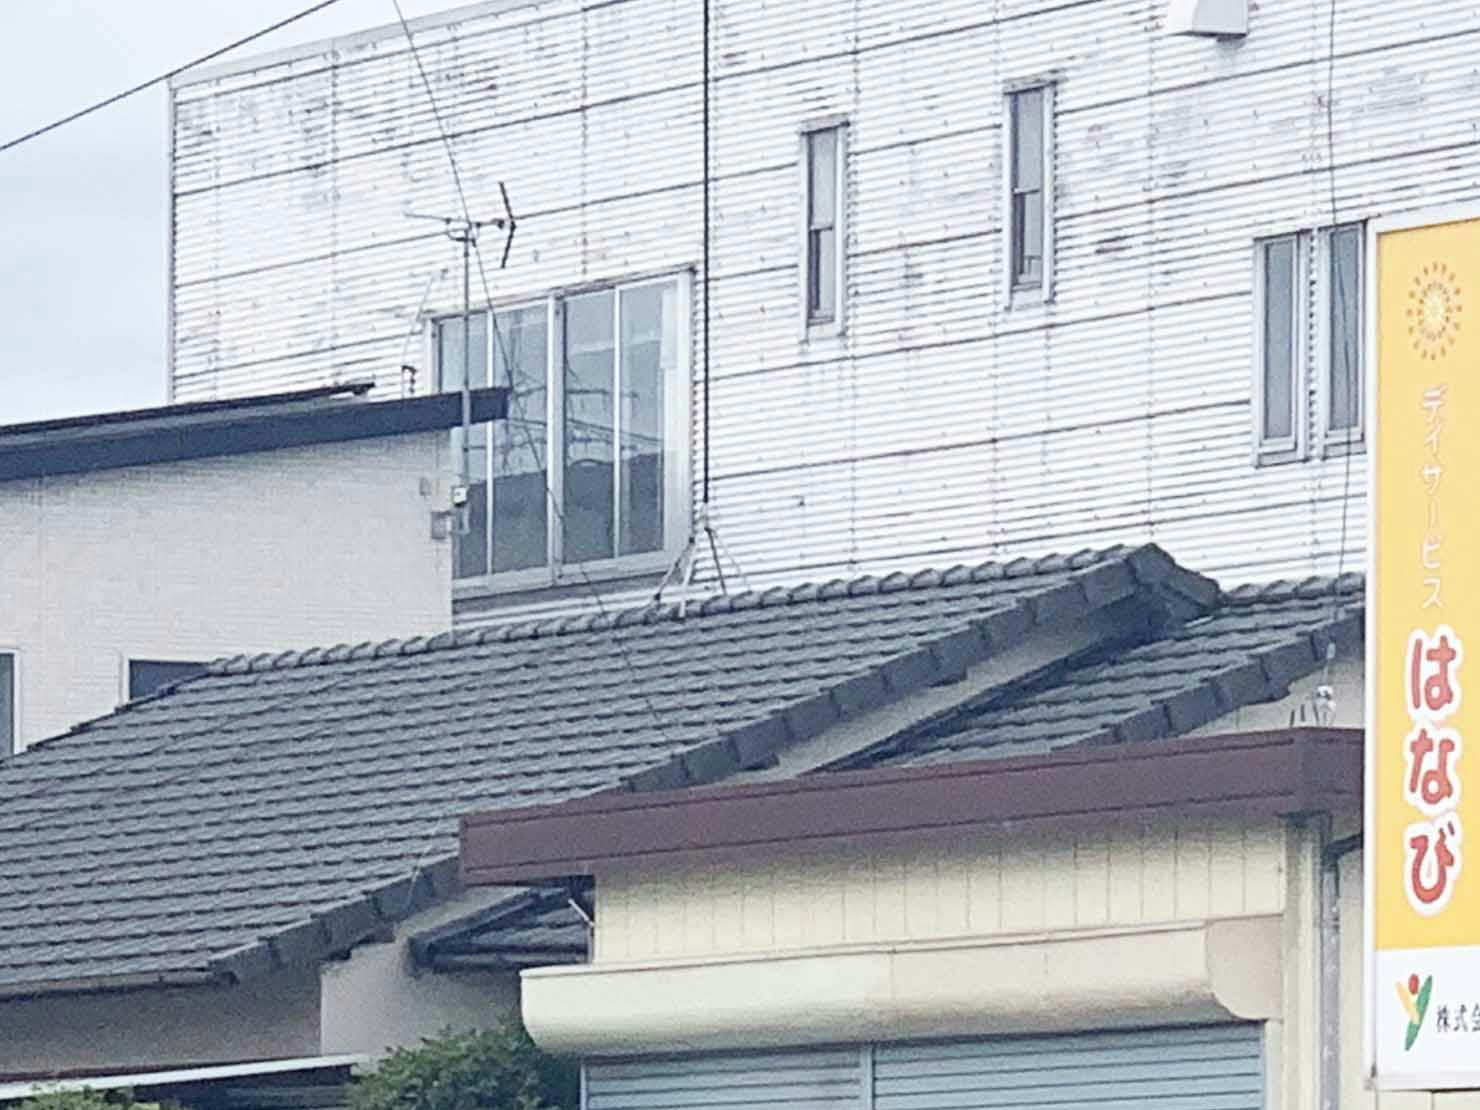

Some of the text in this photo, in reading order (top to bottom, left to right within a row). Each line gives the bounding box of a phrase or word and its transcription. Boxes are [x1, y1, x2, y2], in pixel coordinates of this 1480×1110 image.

[1420, 384, 1448, 608] デイサービス
[1408, 633, 1458, 905] はなび
